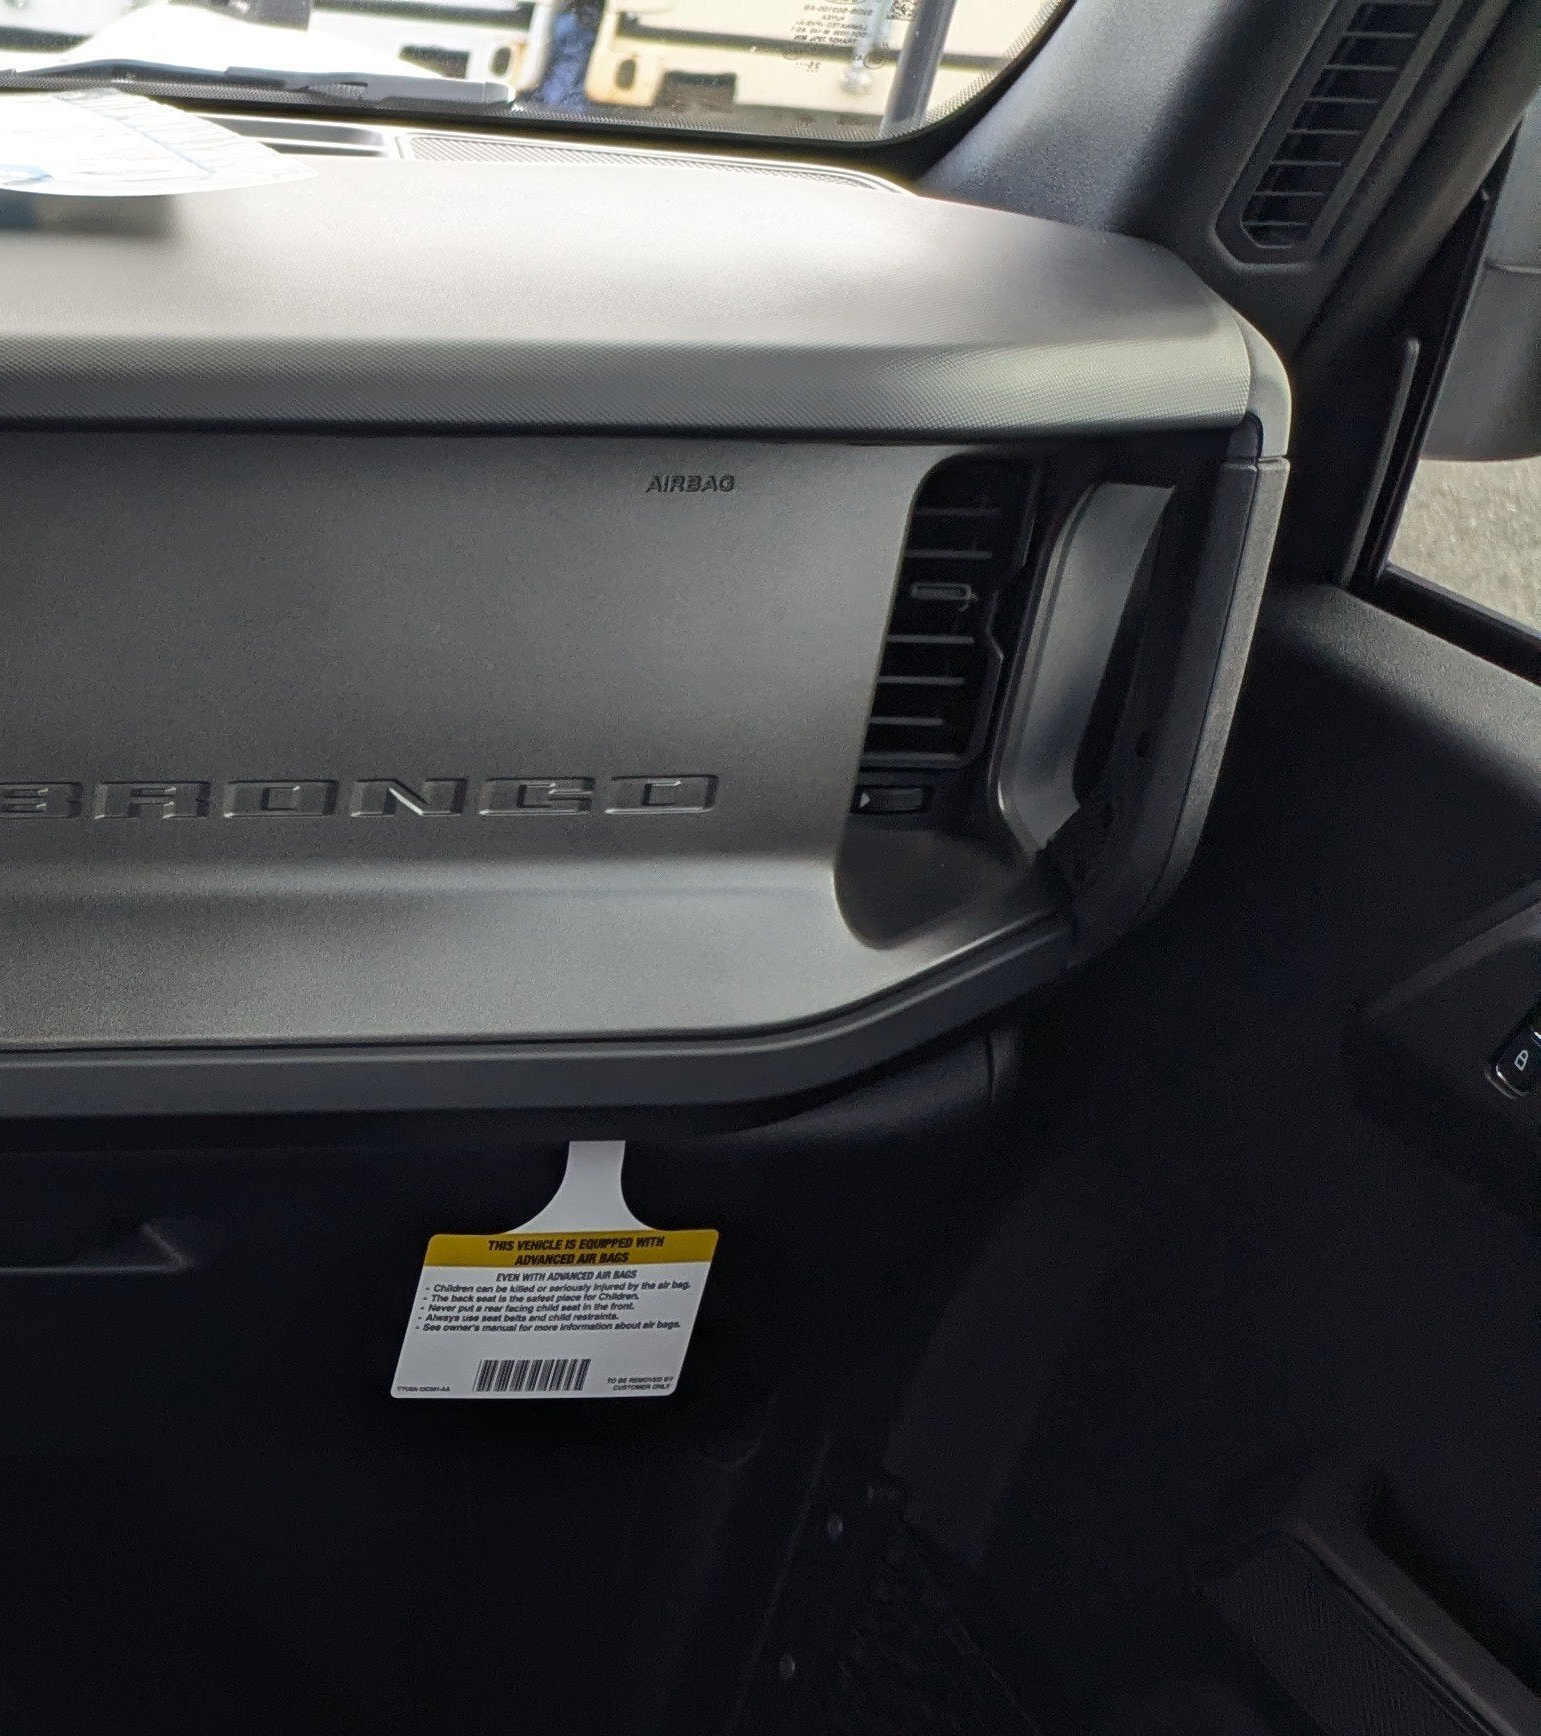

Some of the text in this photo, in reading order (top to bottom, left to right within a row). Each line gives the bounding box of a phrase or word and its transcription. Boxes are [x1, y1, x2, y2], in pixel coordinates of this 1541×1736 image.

[644, 474, 736, 494] AIRBAG
[488, 1236, 665, 1251] THIS VEHICLE IS EQUIPPED WITH
[514, 1252, 631, 1266] ADVANCED AIR BAGS
[496, 1270, 637, 1282] EVEN WITH ADVANCED AIR BAGS
[433, 1284, 474, 1293] Children
[495, 1285, 507, 1293] be
[549, 1283, 591, 1293] seriously
[593, 1282, 626, 1292] injured
[627, 1282, 639, 1292] by
[641, 1281, 656, 1290] the
[432, 1294, 449, 1303] The
[428, 1304, 456, 1312] Never
[458, 1304, 475, 1313] put
[425, 1313, 460, 1323] Always
[422, 1323, 442, 1331] See
[481, 1323, 517, 1331] manual
[518, 1323, 532, 1331] for
